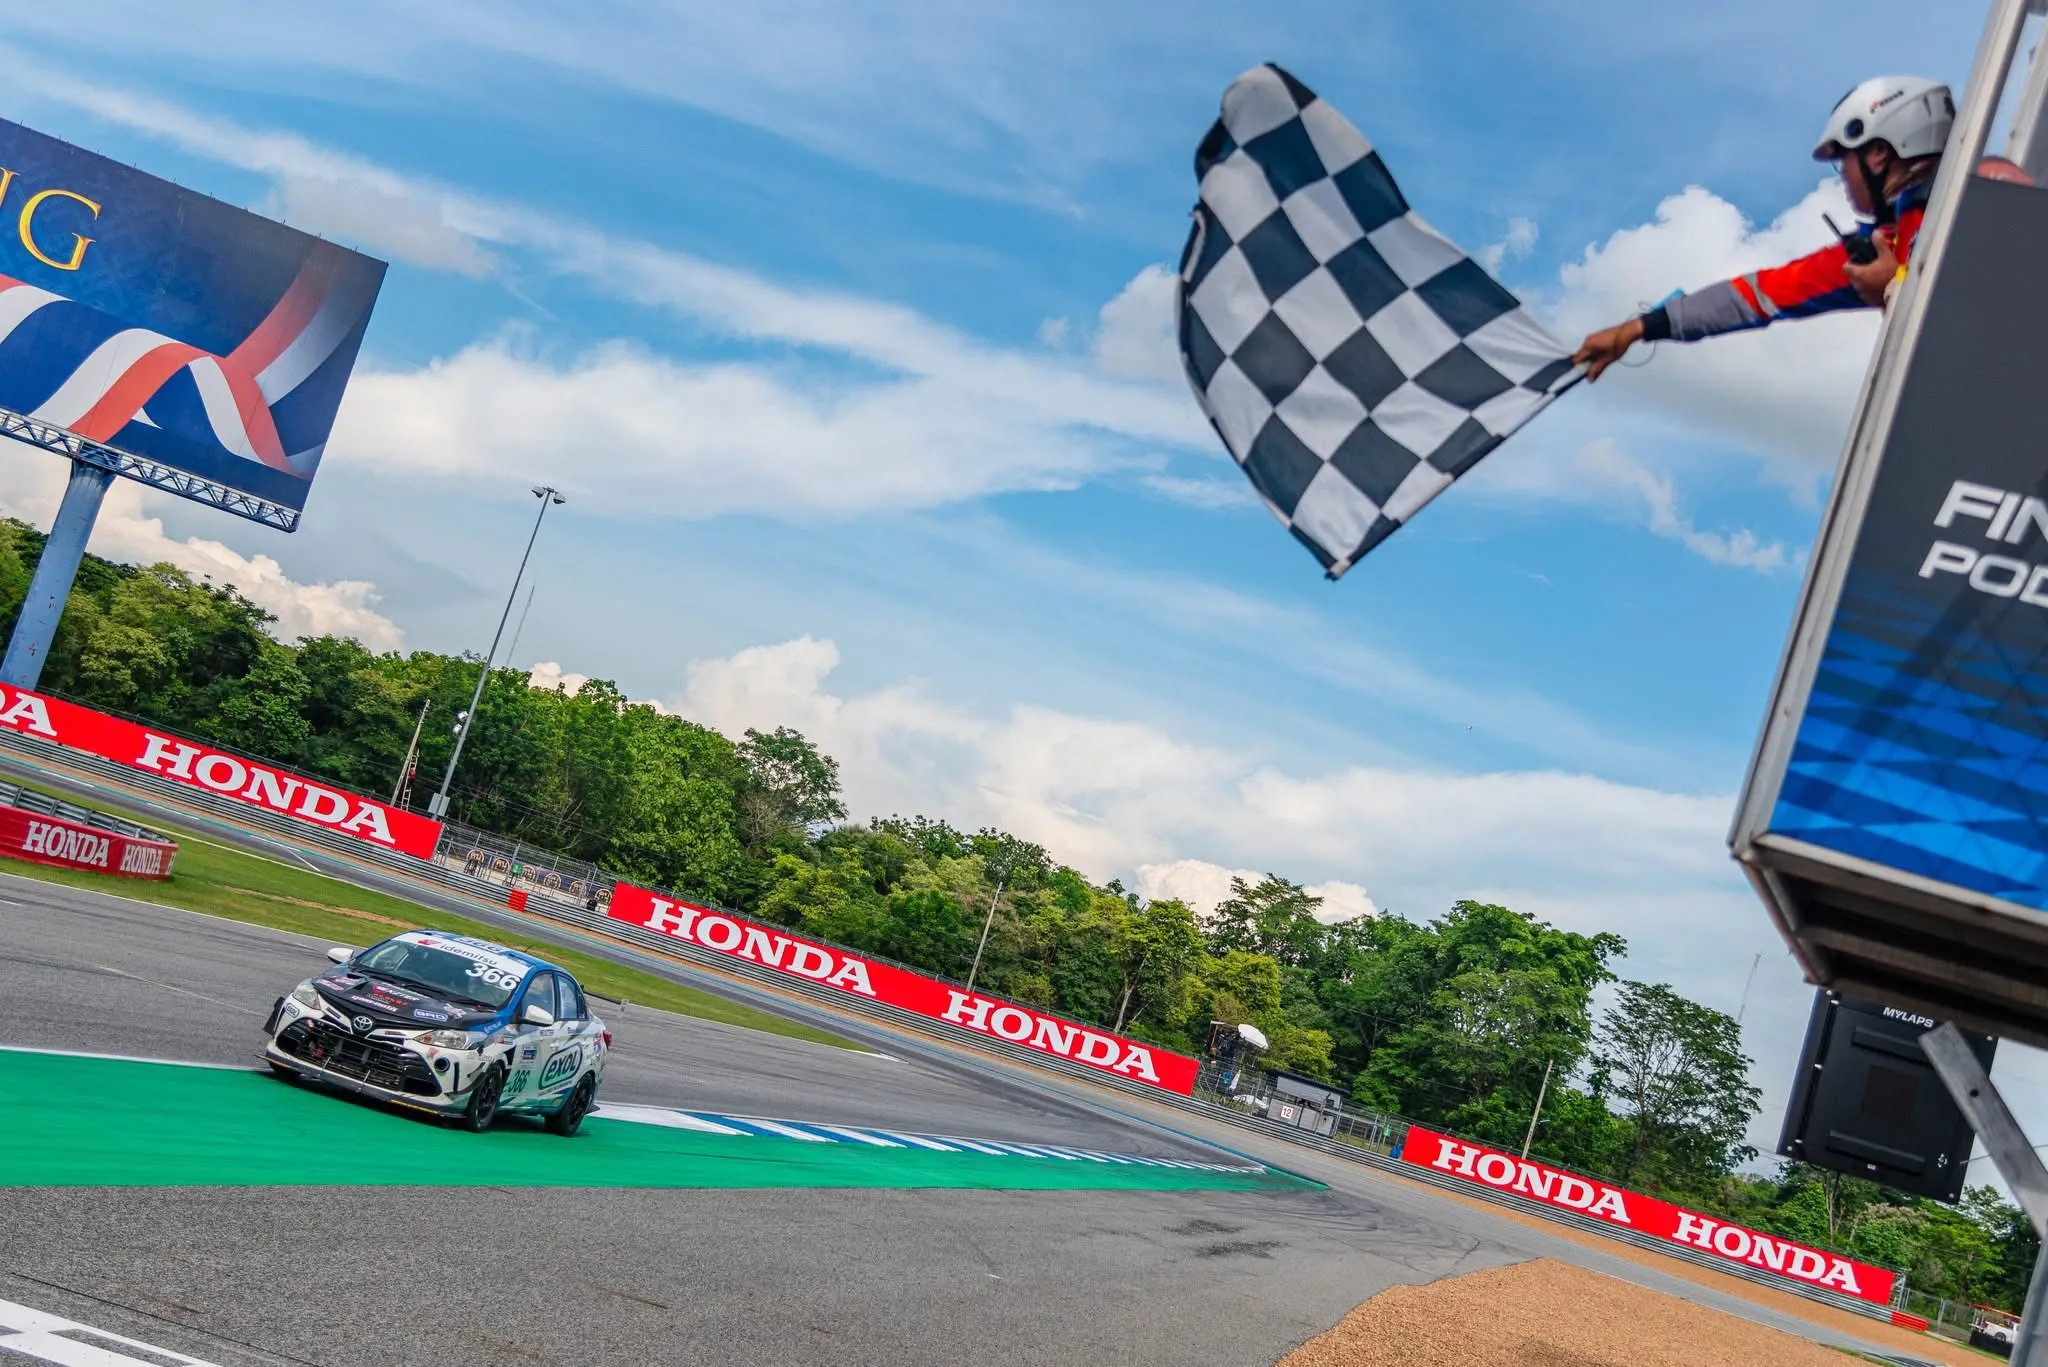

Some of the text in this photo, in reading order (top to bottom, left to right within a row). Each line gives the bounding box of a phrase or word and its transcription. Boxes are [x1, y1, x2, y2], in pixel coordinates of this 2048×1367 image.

[0, 167, 102, 270] G
[0, 689, 58, 737] A
[136, 733, 396, 844] HONDA
[22, 821, 110, 867] HONDA
[120, 843, 163, 875] HONDA
[440, 943, 498, 966] idemitsu
[643, 897, 877, 997] HONDA
[465, 962, 521, 990] 366
[941, 990, 1160, 1084] HONDA
[1882, 1006, 1934, 1028] MYLAPS
[508, 1069, 531, 1093] 366
[1431, 1138, 1632, 1224] HONDA
[1672, 1211, 1862, 1295] HONDA
